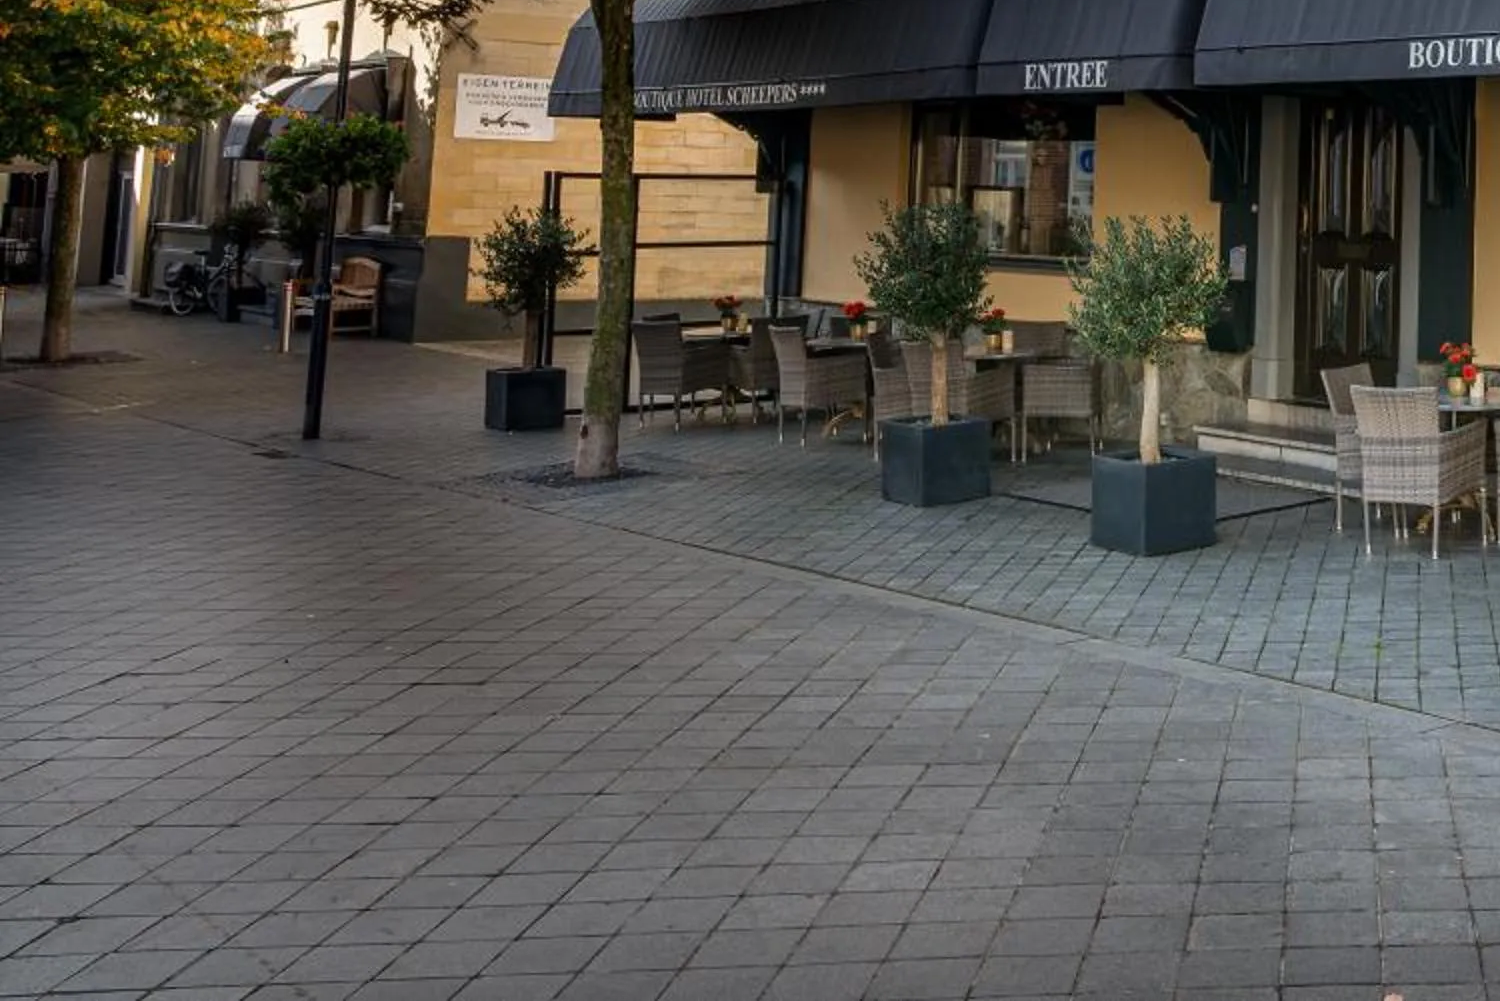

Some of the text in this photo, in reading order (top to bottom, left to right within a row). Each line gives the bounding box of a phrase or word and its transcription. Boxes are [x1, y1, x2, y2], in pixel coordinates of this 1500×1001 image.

[1023, 60, 1109, 90] ENTREE
[685, 86, 724, 107] HOTEL
[726, 82, 798, 106] SCHEEPERS
